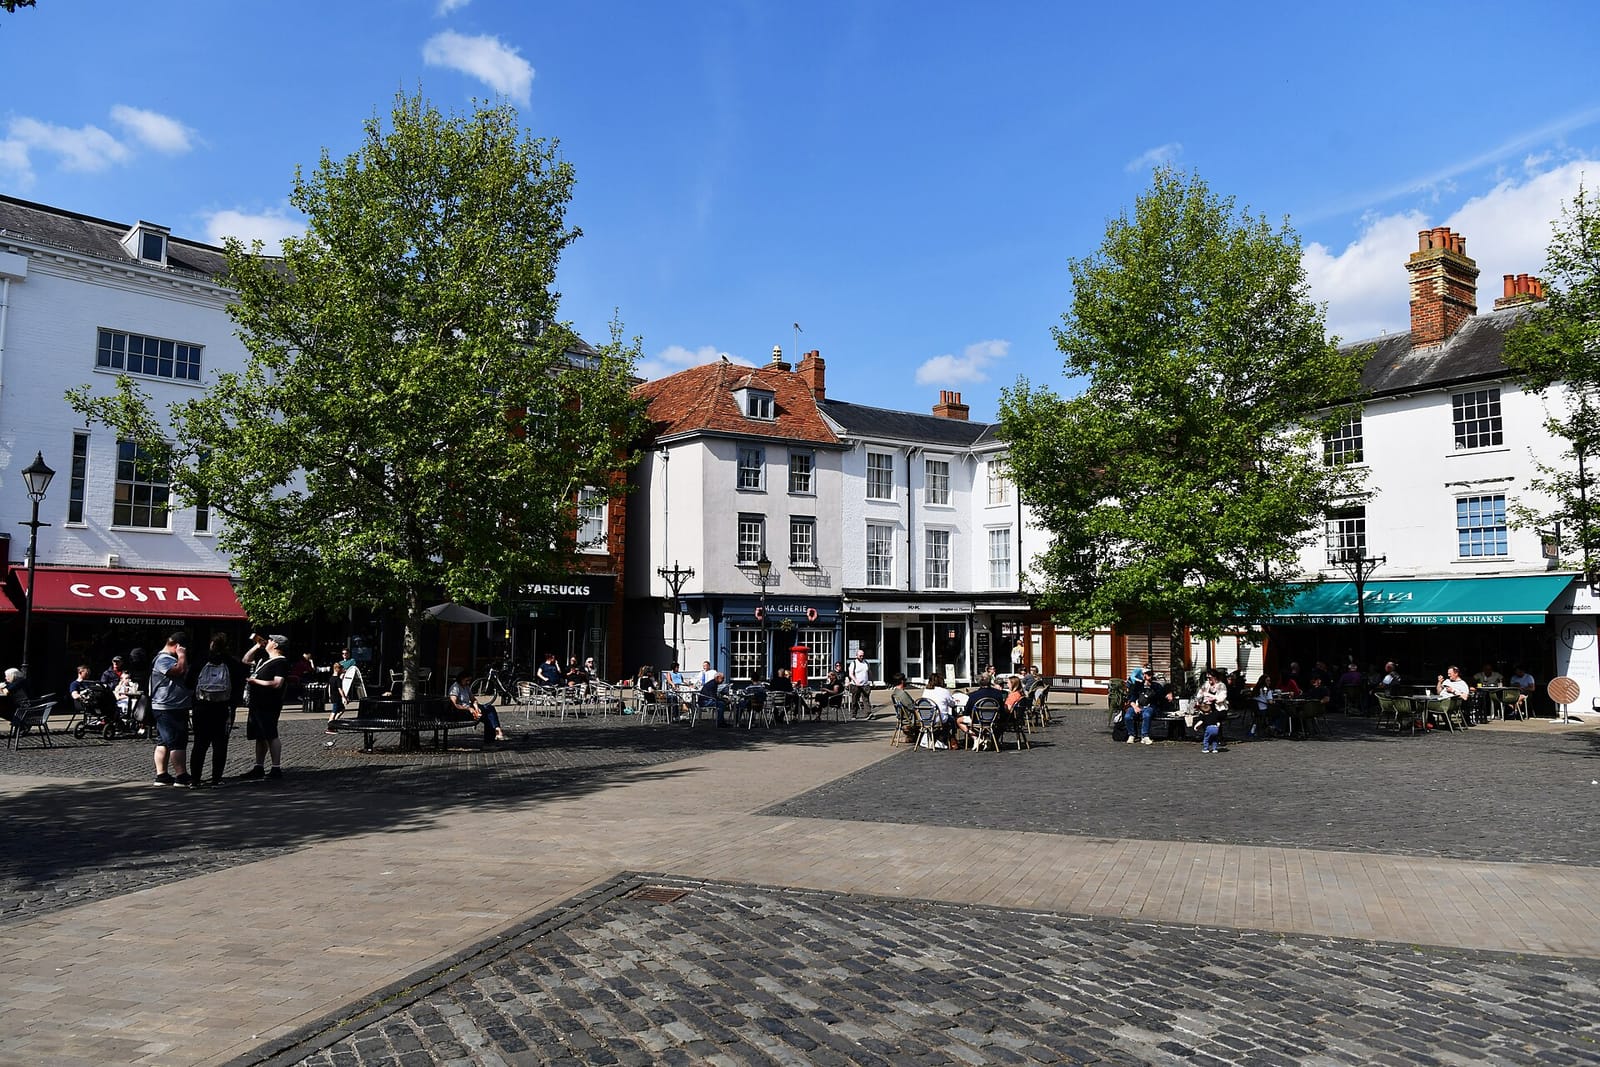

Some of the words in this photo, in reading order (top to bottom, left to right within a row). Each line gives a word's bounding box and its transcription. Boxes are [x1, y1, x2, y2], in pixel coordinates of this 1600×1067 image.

[70, 583, 200, 602] COSTA
[1343, 590, 1413, 605] JAVA
[126, 617, 156, 625] COFFEE
[157, 618, 185, 626] LOVERS
[1332, 616, 1358, 624] FRESH
[1388, 616, 1438, 624] SMOOTHIES
[1446, 615, 1503, 624] MILKSHAKES
